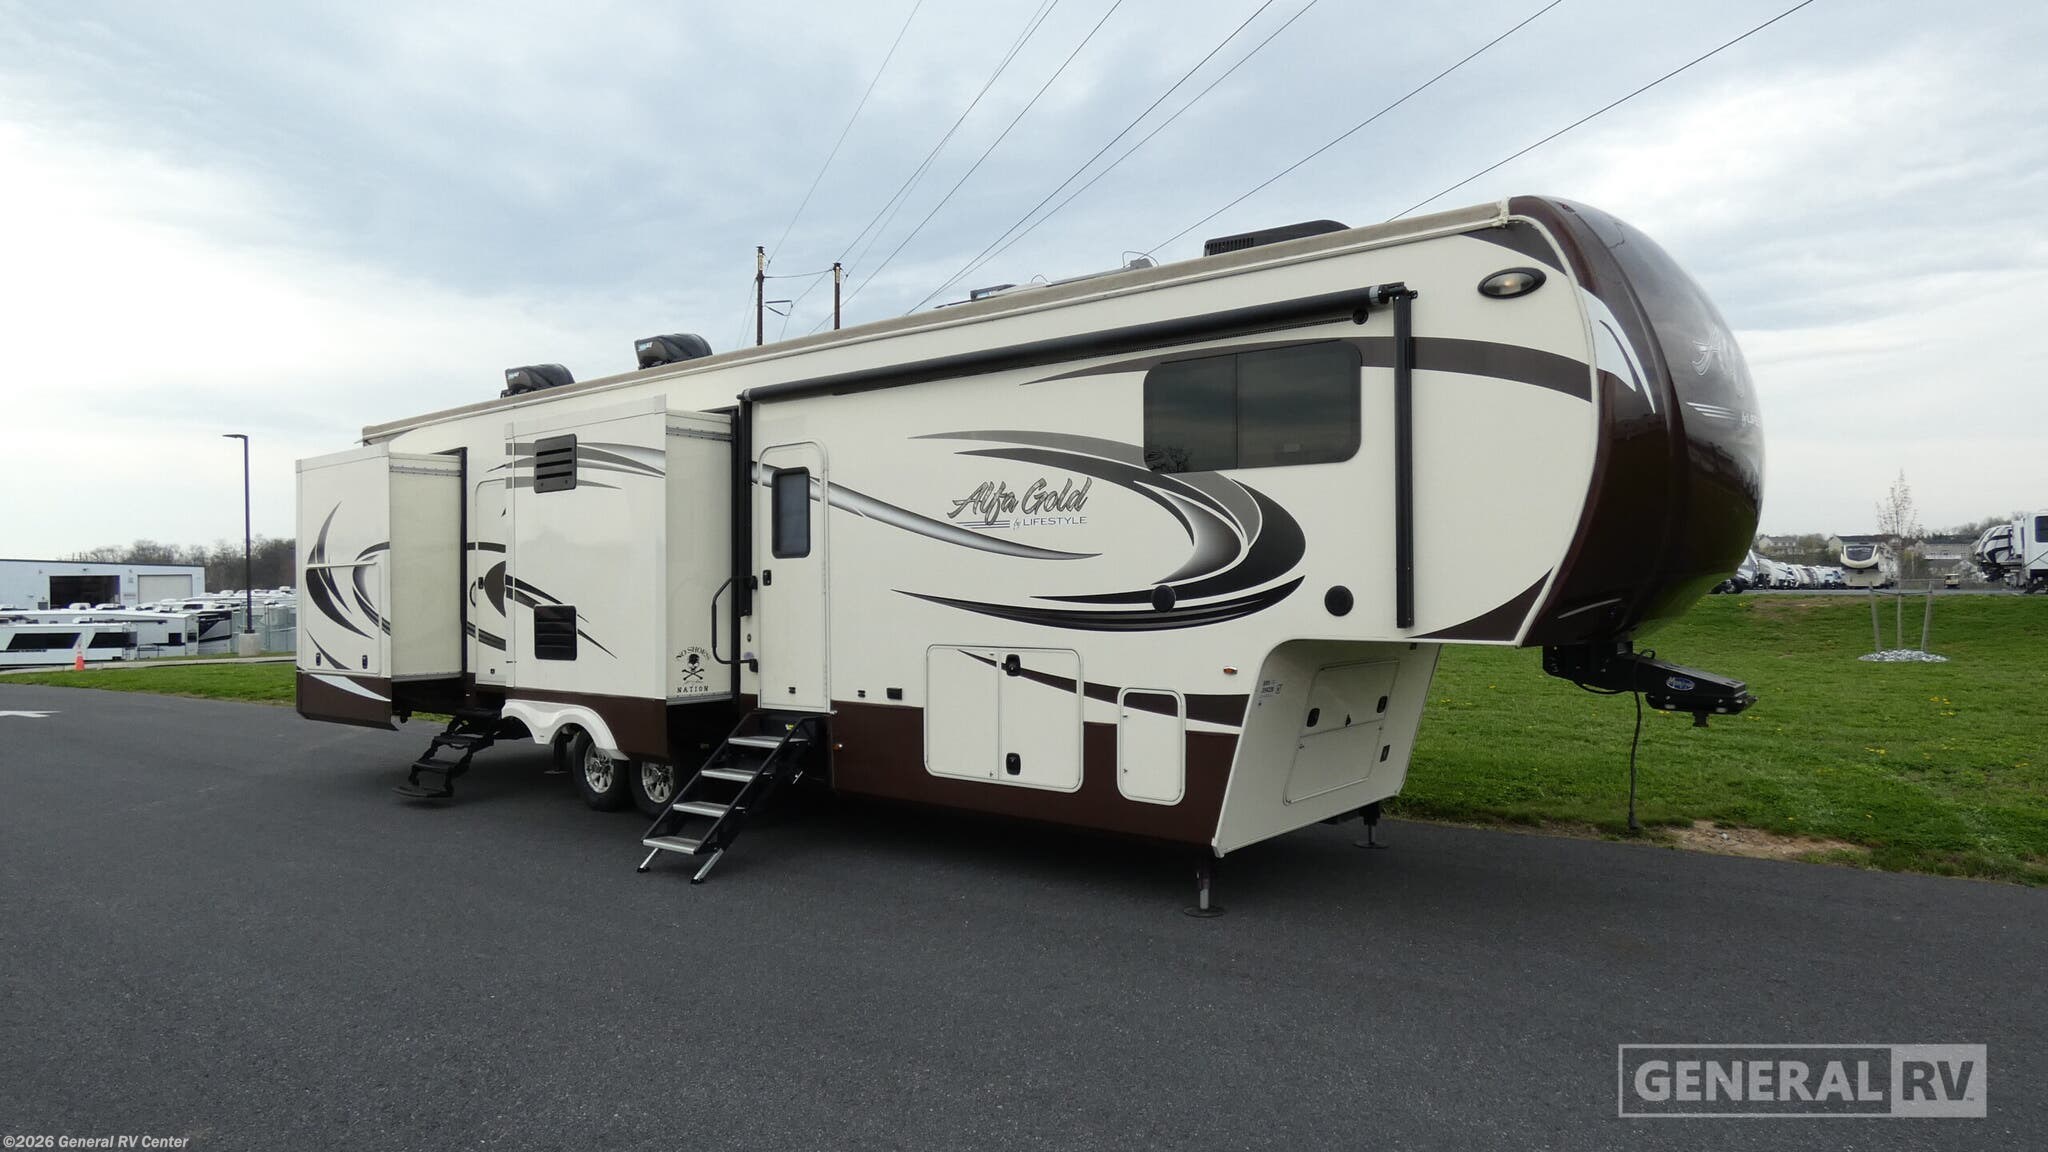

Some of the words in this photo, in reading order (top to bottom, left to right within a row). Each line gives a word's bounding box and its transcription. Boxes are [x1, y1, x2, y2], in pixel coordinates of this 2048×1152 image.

[947, 481, 1019, 525] Alfa
[1021, 477, 1092, 515] Gold
[1023, 516, 1088, 526] LIFESTYLE
[677, 685, 709, 693] NATION
